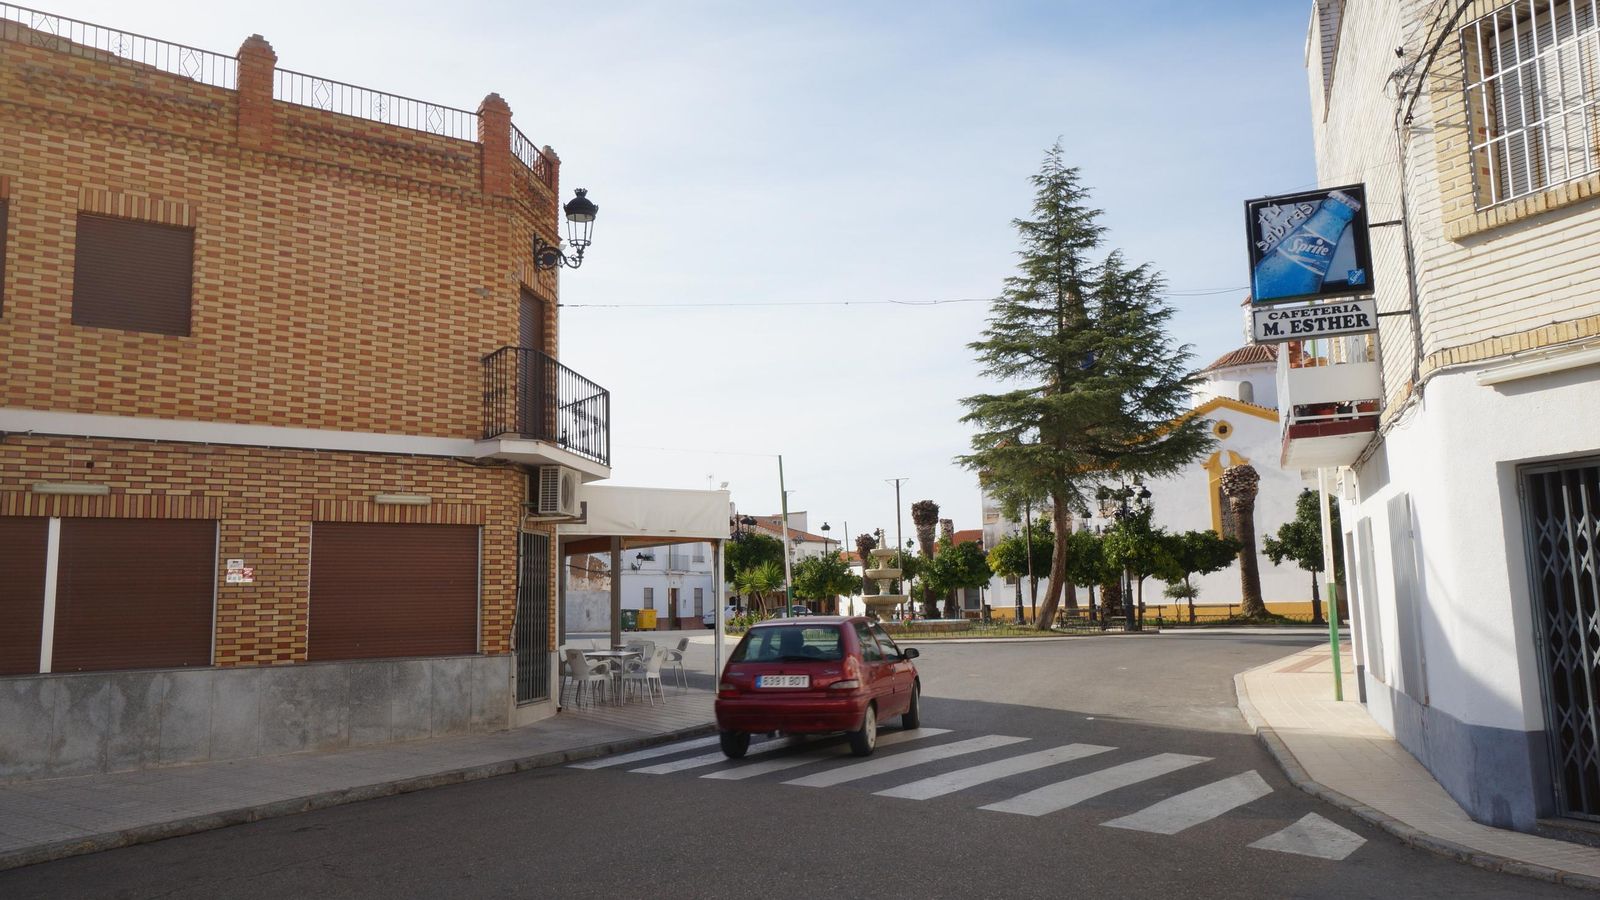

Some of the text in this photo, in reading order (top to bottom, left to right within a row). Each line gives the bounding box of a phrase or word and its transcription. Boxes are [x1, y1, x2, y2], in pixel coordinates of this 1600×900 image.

[1288, 238, 1329, 256] Sprite
[1268, 304, 1361, 320] CAFETERIA
[1263, 313, 1370, 337] M. ESTHER
